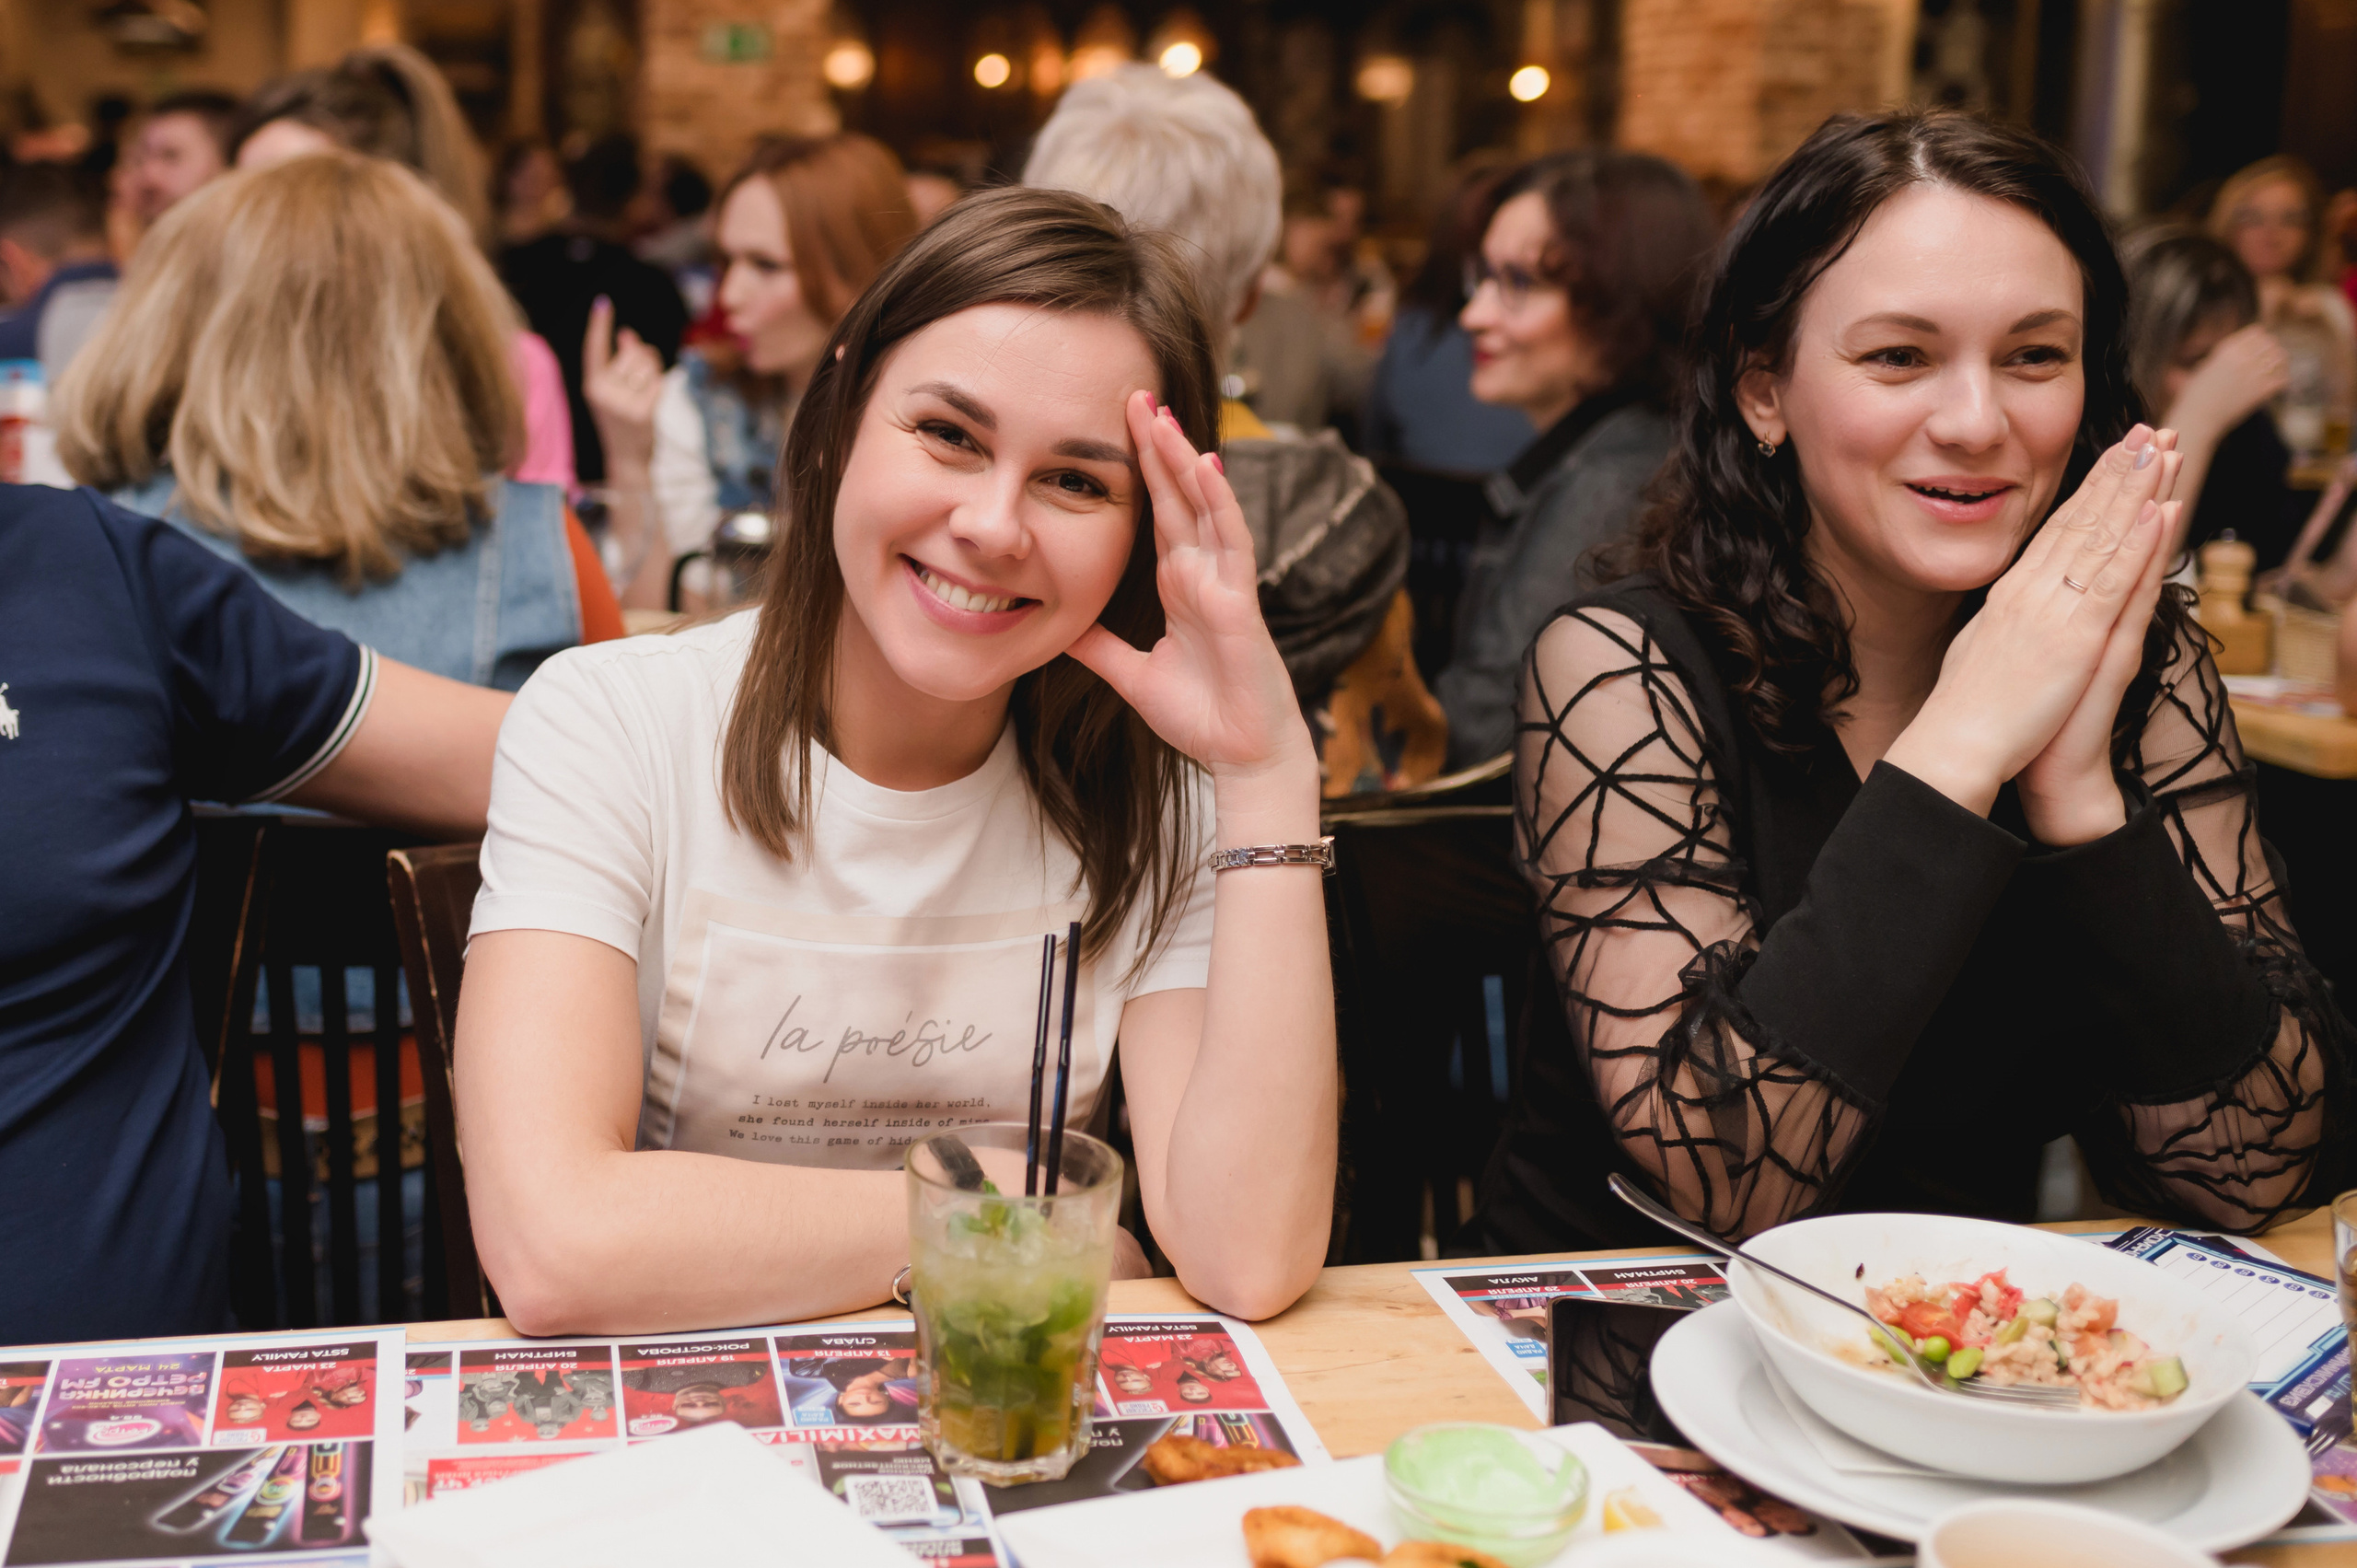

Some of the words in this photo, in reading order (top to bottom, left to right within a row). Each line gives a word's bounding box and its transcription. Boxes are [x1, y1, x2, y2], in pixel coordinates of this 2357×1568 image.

[760, 994, 824, 1060] la
[823, 1010, 993, 1084] poésie
[752, 1095, 761, 1105] I
[767, 1097, 799, 1108] lost
[807, 1098, 856, 1110] myself
[862, 1099, 908, 1109] inside
[915, 1099, 940, 1109] her
[947, 1097, 991, 1109] world,
[738, 1115, 763, 1124] she
[772, 1116, 815, 1127] found
[822, 1118, 880, 1128] herself
[885, 1118, 931, 1128] inside
[937, 1118, 954, 1127] of
[729, 1129, 744, 1139] We
[751, 1132, 783, 1143] love
[790, 1134, 820, 1144] this
[827, 1136, 860, 1147] game
[867, 1136, 884, 1145] of
[1614, 1269, 1687, 1279] БИРТМАН
[1488, 1276, 1538, 1284] АКУЛА
[1625, 1280, 1678, 1288] АПРЕЛЯ
[1488, 1286, 1541, 1295] АПРЕЛЯ
[1108, 1325, 1160, 1333] FAMILY
[1124, 1335, 1175, 1343] МАРТА
[311, 1348, 350, 1357] 5STA
[637, 1342, 750, 1355] РОК-ОСТРОВА
[250, 1351, 309, 1362] FAMILY
[494, 1350, 577, 1360] БИРТМАН
[656, 1356, 717, 1365] АПРЕЛЯ
[95, 1364, 151, 1374] МАРТА
[262, 1364, 316, 1373] МАРТА
[495, 1363, 557, 1371] АПРЕЛЯ
[60, 1377, 101, 1390] FM
[106, 1372, 208, 1388] РЕТРО
[58, 1384, 205, 1400] ВЕЧЕРИНКА
[755, 1428, 921, 1444] MAXIMILIA
[60, 1459, 180, 1474] персонала
[185, 1456, 200, 1469] у
[46, 1468, 197, 1486] подробности
